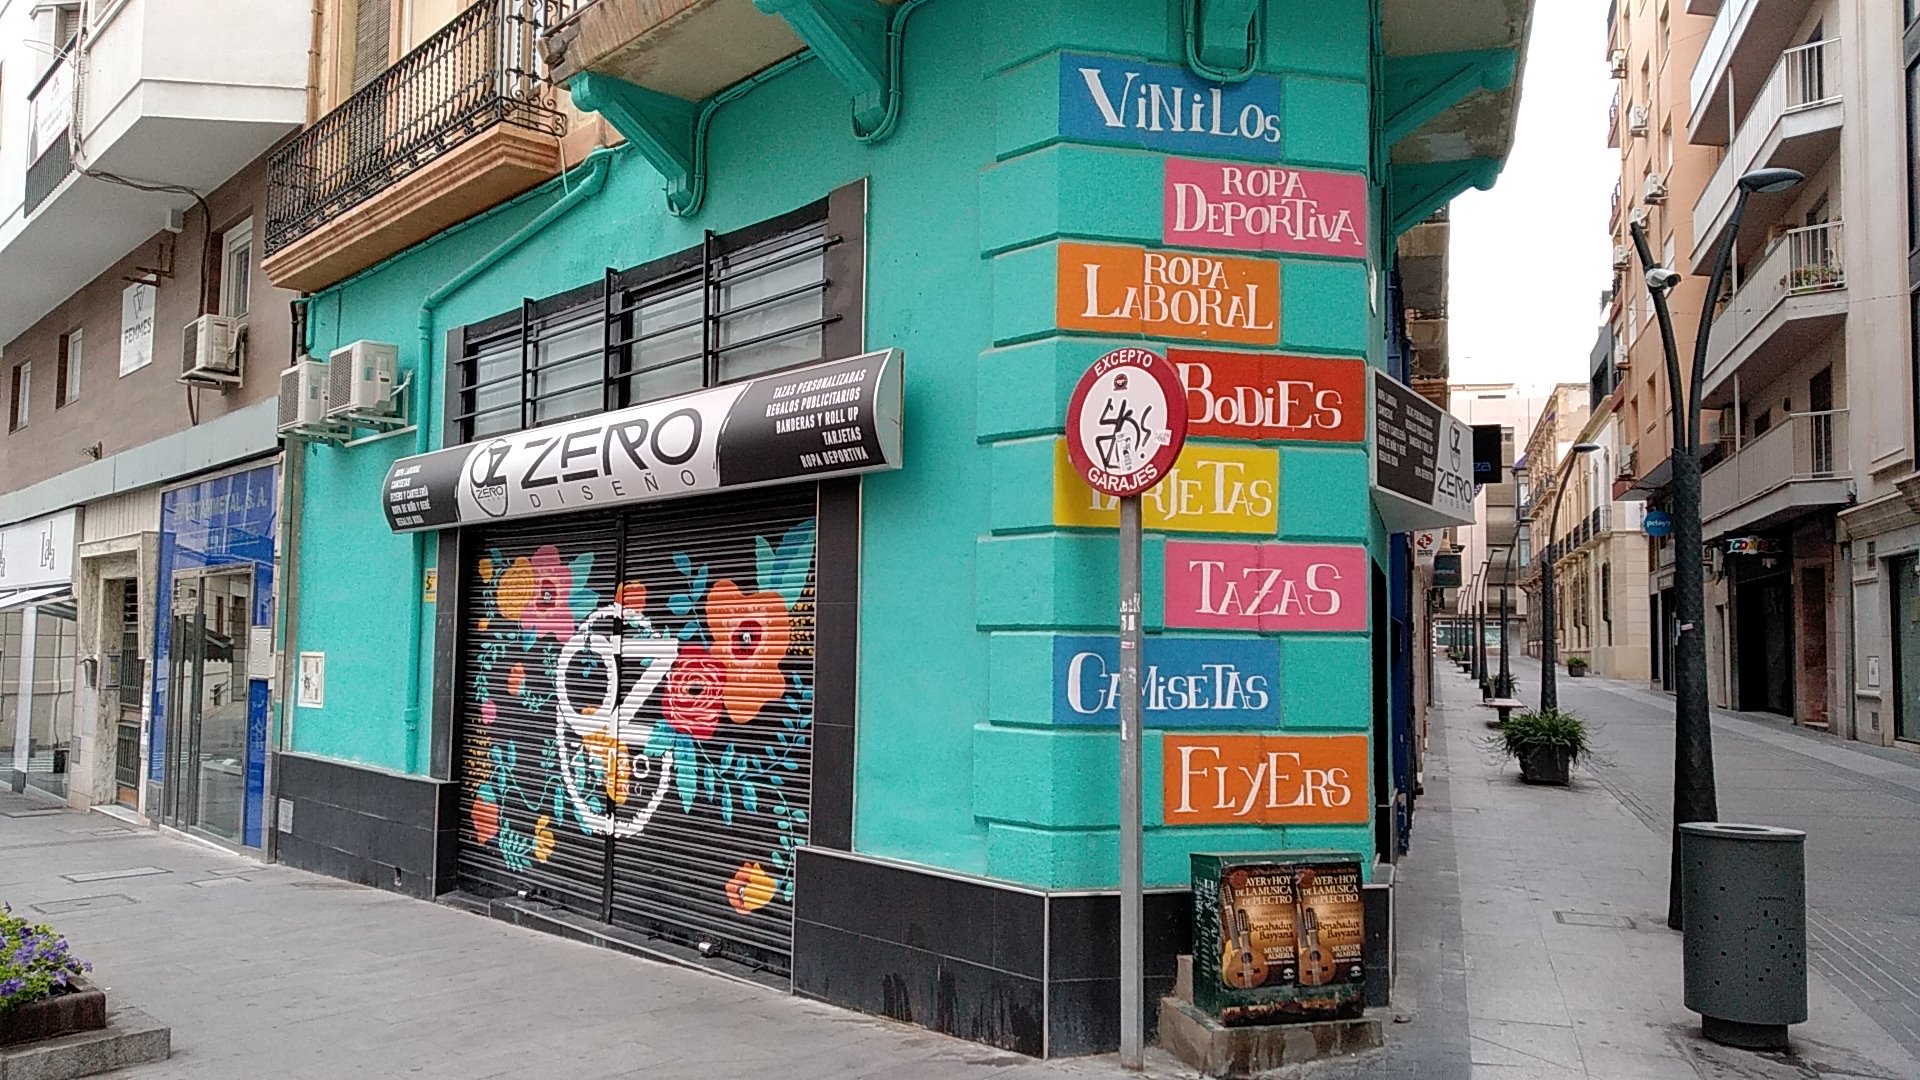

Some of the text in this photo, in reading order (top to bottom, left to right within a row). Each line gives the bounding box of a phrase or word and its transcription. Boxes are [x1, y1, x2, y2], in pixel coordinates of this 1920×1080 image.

[1222, 167, 1307, 198] ROPA
[1144, 253, 1229, 289] ROPA
[1081, 264, 1273, 330] LABORAL
[125, 316, 152, 344] FEMMES
[1094, 350, 1153, 377] EXCEPTO
[773, 368, 867, 399] TAZAS PERSONALIZADAS
[765, 387, 861, 417] REGALOS PUBLICITARIOS
[776, 406, 859, 434] BANDERAS Y ROLL UP
[521, 408, 702, 489] ZERO
[822, 427, 862, 446] TARJETAS
[800, 446, 869, 468] ROPA DEPORTIVA
[529, 470, 696, 508] DISEÑO
[1087, 464, 1158, 491] GARAJES
[1437, 467, 1473, 503] ZERO
[476, 486, 504, 499] ZERO
[1189, 560, 1342, 617] TAZAS
[1245, 876, 1267, 886] AYER
[1272, 875, 1291, 885] HOY
[1312, 875, 1333, 885] AYER
[1339, 874, 1358, 884] HOY
[1253, 895, 1293, 905] PLECTRO
[1320, 893, 1359, 904] PLECTRO
